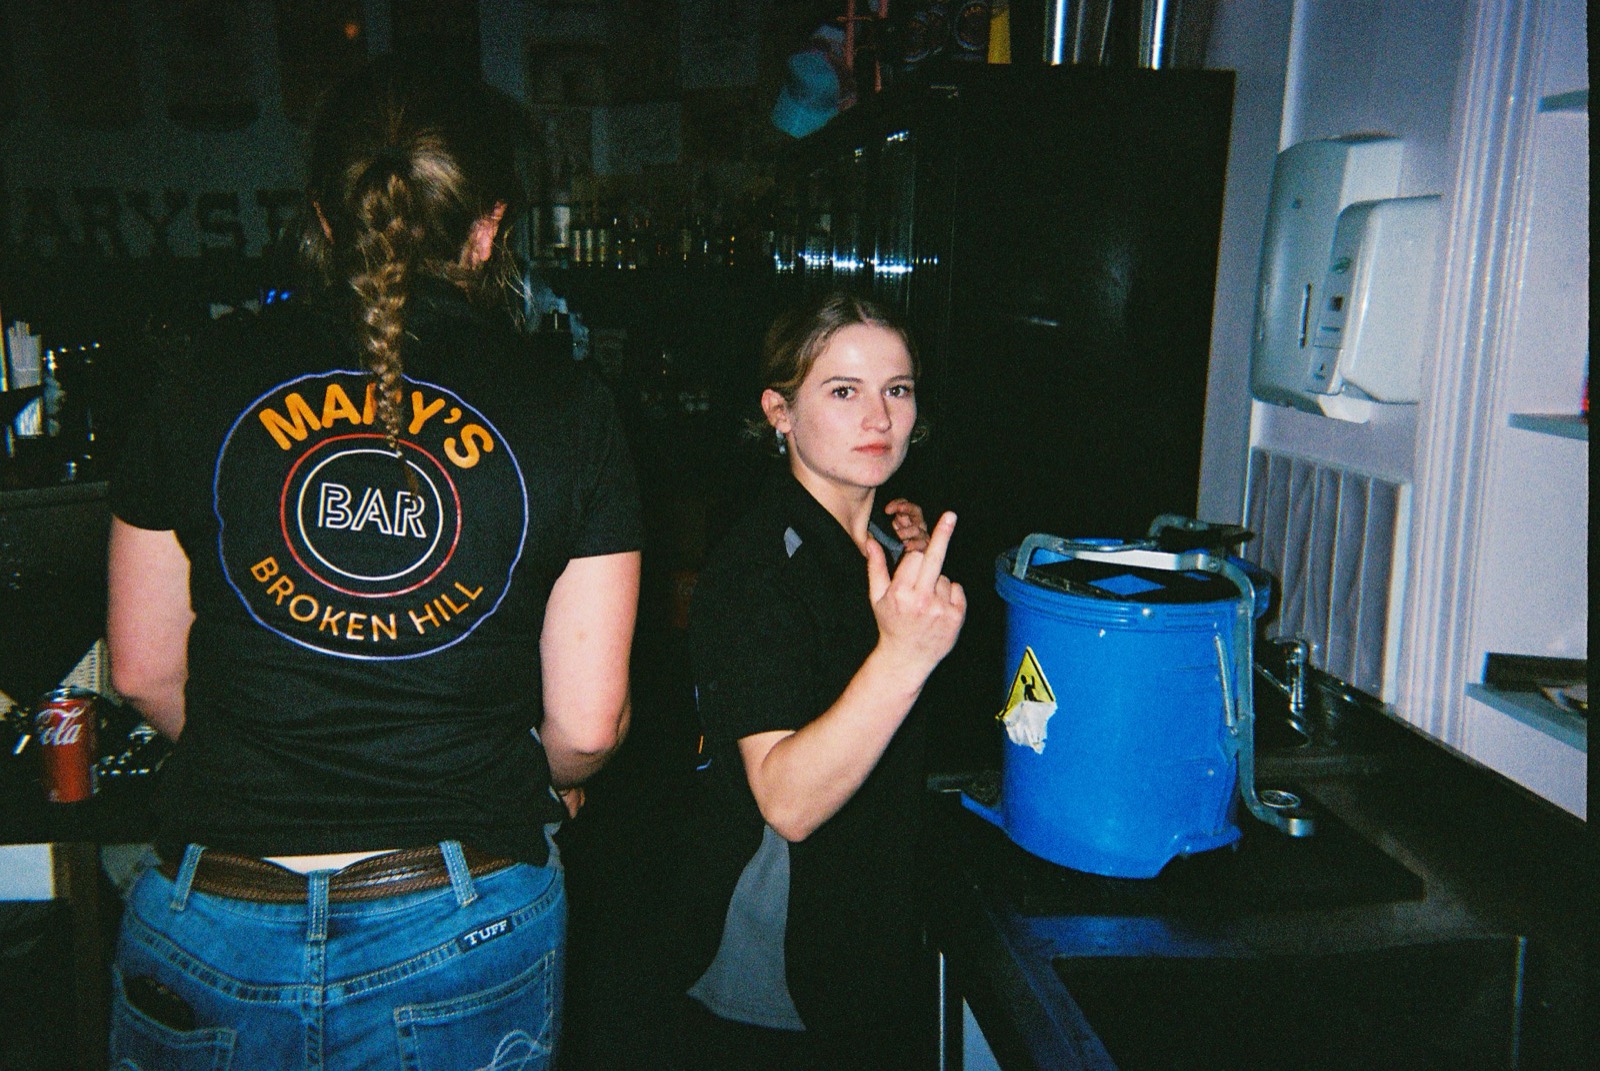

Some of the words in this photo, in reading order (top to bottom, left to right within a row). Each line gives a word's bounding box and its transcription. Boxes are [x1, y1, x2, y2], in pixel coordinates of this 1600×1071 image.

[317, 482, 427, 538] BAR
[251, 556, 397, 641] BROKEN
[408, 581, 483, 635] HILL
[34, 705, 84, 746] Cola
[463, 919, 507, 946] TUFF
